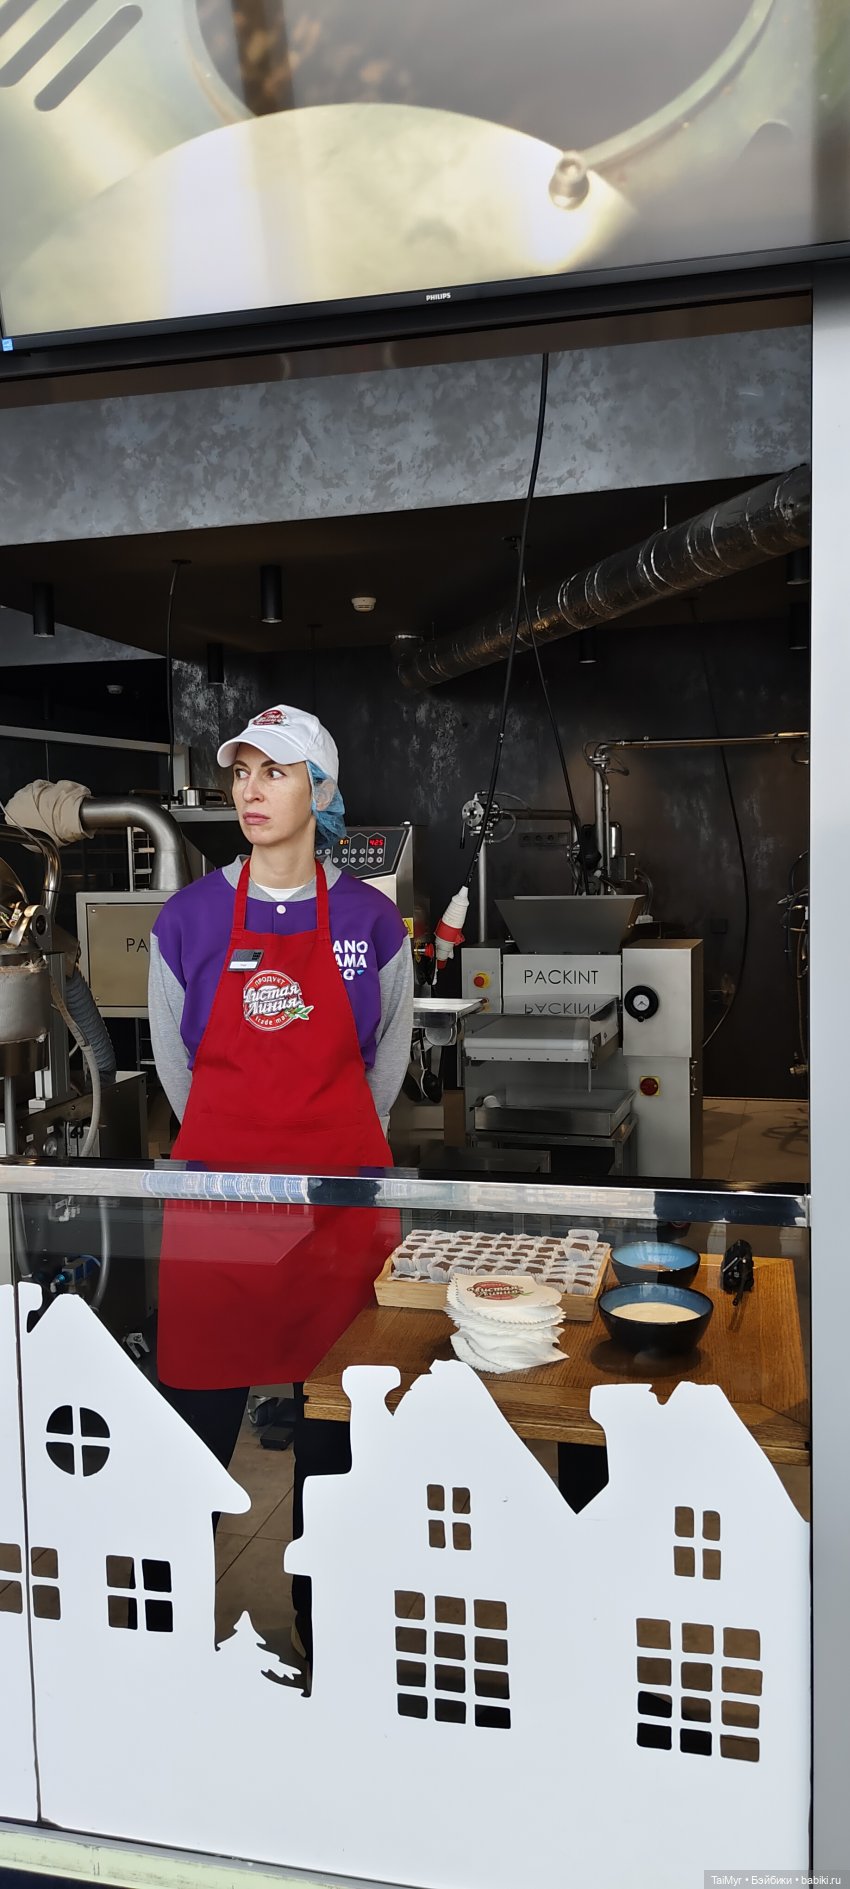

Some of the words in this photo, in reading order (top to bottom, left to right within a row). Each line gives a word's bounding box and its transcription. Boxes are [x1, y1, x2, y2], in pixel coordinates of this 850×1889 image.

[426, 292, 451, 301] PHILIPS
[126, 938, 149, 953] PA
[333, 940, 368, 953] ANO
[335, 953, 368, 968] AMA
[254, 976, 286, 987] ПРОДУКТ
[524, 969, 599, 985] PACKINT
[247, 997, 304, 1017] Линия
[255, 1015, 273, 1026] trade
